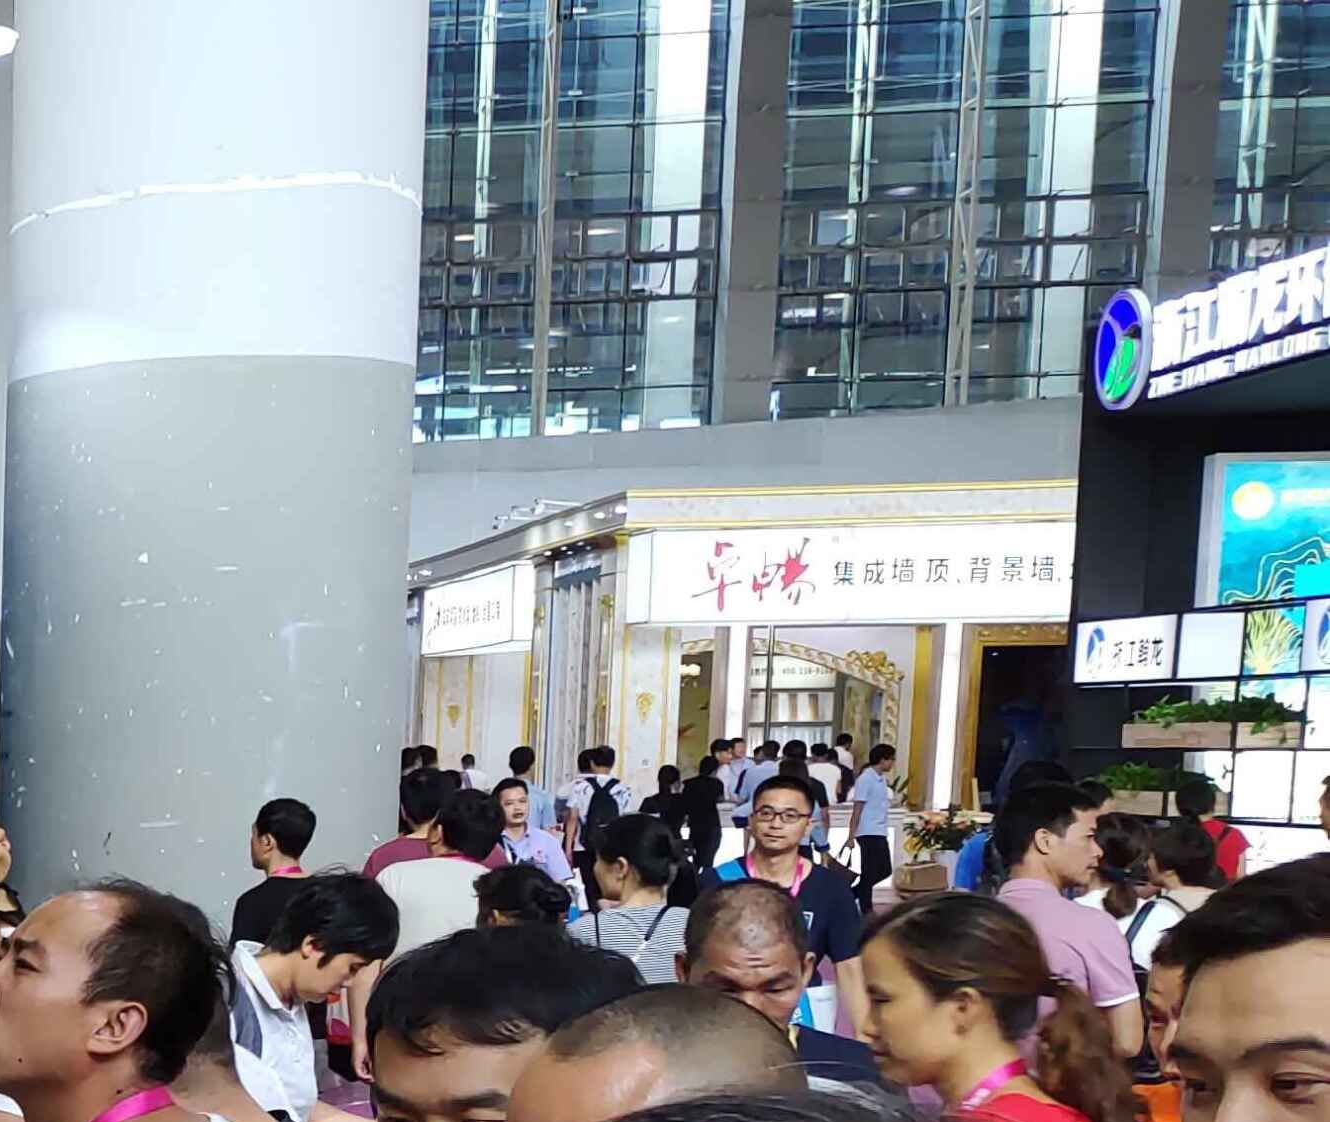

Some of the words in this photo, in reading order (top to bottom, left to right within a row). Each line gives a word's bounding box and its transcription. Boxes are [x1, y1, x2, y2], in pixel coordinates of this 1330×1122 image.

[833, 554, 1076, 587] 集成墙顶、背景墙、
